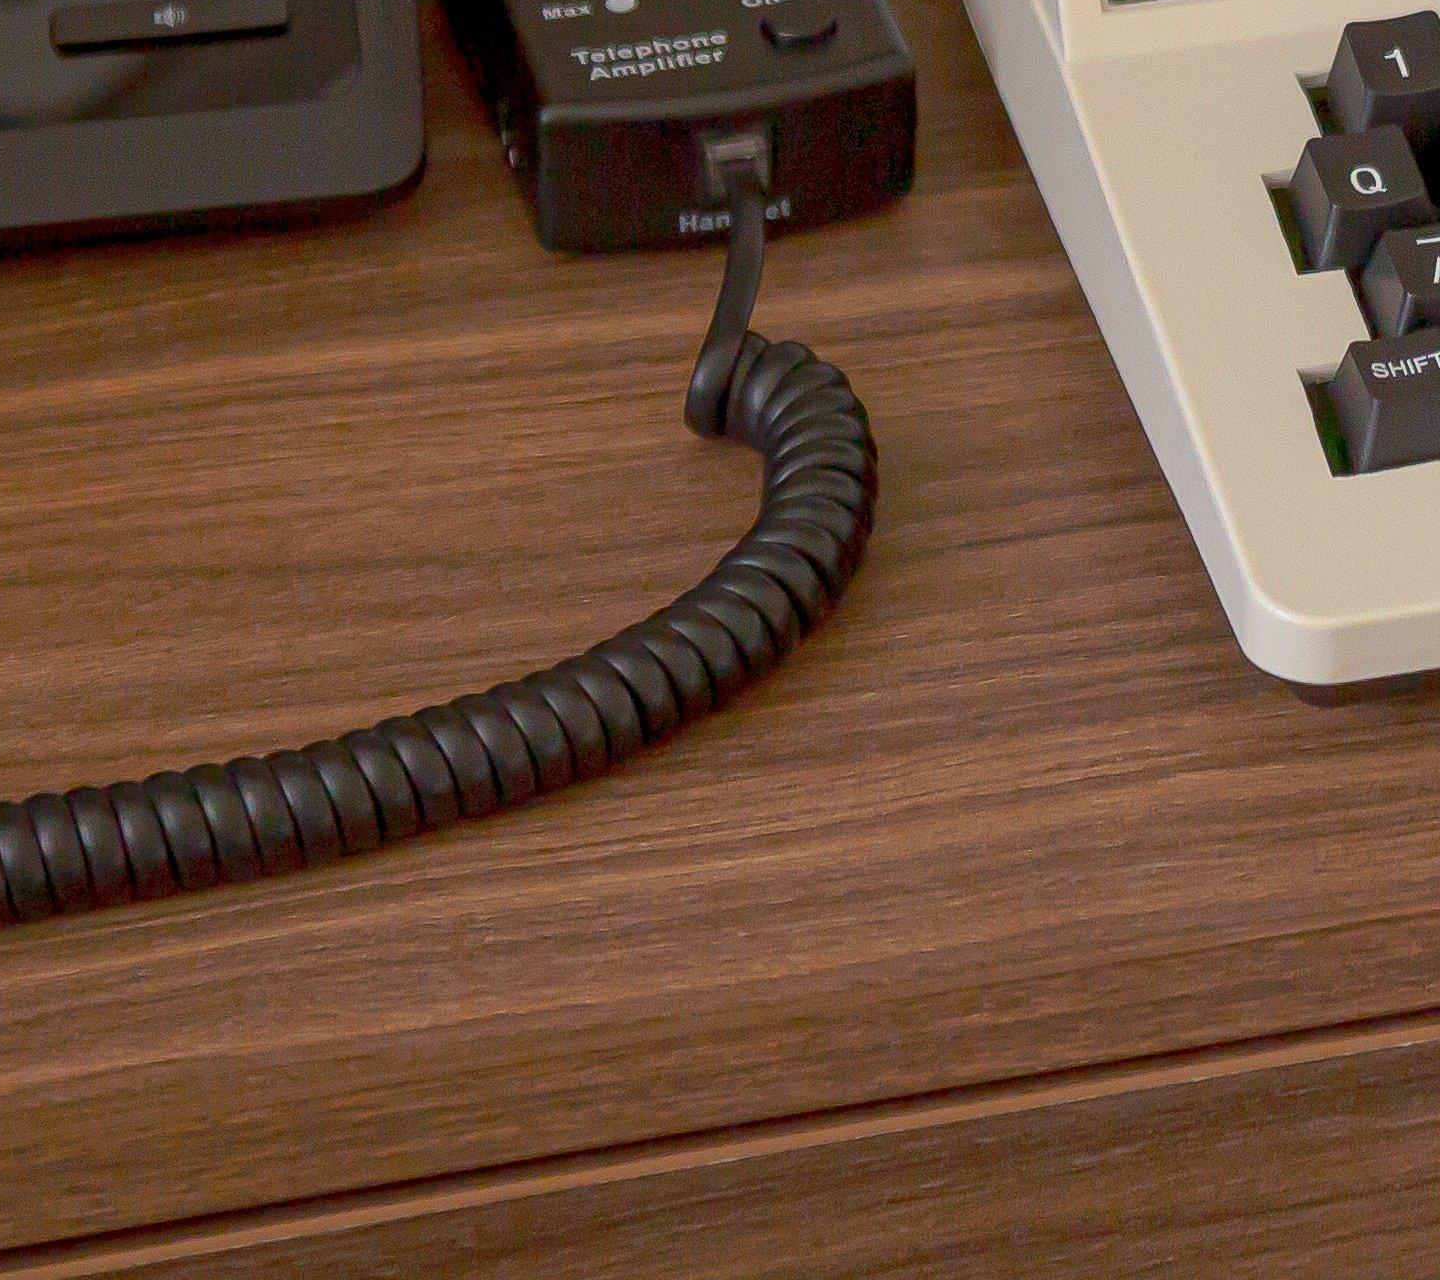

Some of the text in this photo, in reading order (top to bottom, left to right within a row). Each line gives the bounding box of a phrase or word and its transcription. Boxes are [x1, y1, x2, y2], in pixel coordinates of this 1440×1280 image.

[571, 29, 729, 65] Telephone
[590, 48, 724, 80] Amplifier
[1384, 48, 1409, 78] 1
[1351, 167, 1386, 195] Q
